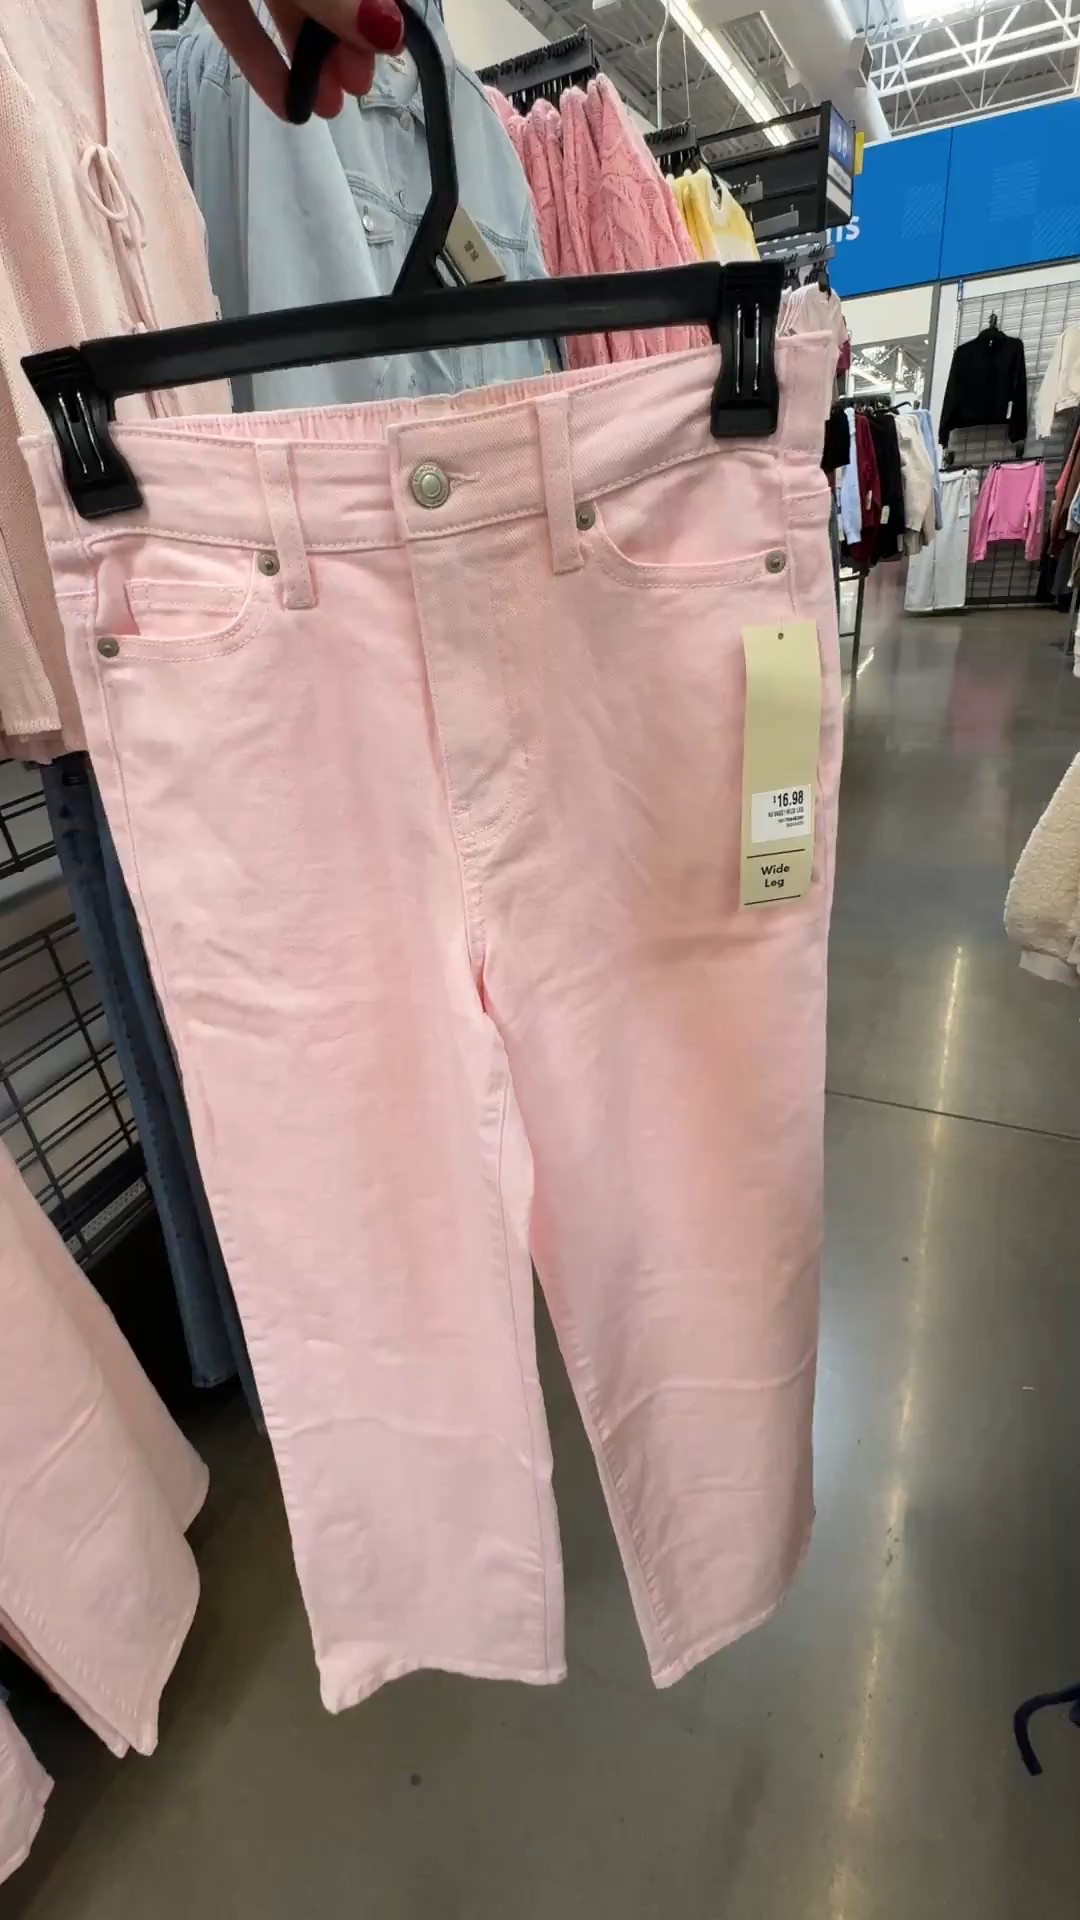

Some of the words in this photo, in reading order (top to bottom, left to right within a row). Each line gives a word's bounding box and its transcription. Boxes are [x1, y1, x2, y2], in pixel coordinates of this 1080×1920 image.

[773, 790, 804, 807] $16.98
[761, 863, 790, 875] Wide
[764, 878, 785, 888] Leg
